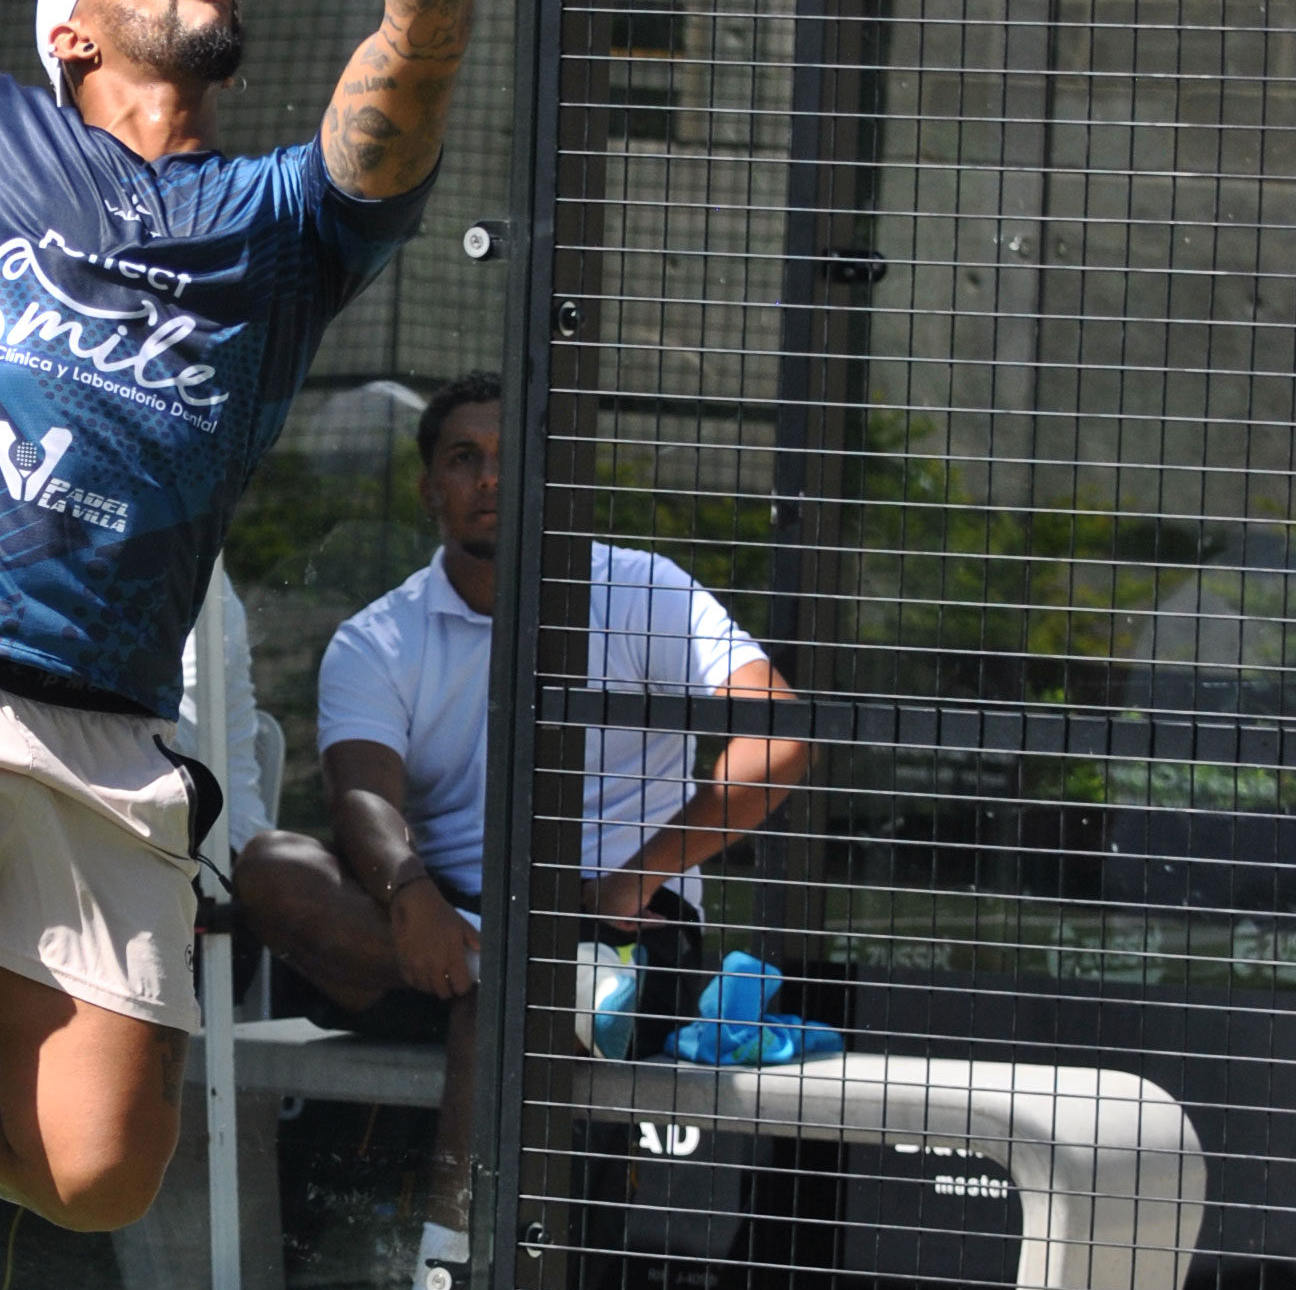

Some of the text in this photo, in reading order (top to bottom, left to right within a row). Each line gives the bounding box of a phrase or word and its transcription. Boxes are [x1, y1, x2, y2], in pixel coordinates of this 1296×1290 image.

[56, 364, 69, 380] y
[72, 369, 167, 414] Laboratorio
[169, 401, 218, 436] Dental
[36, 492, 68, 514] LA
[44, 477, 130, 518] PADEL
